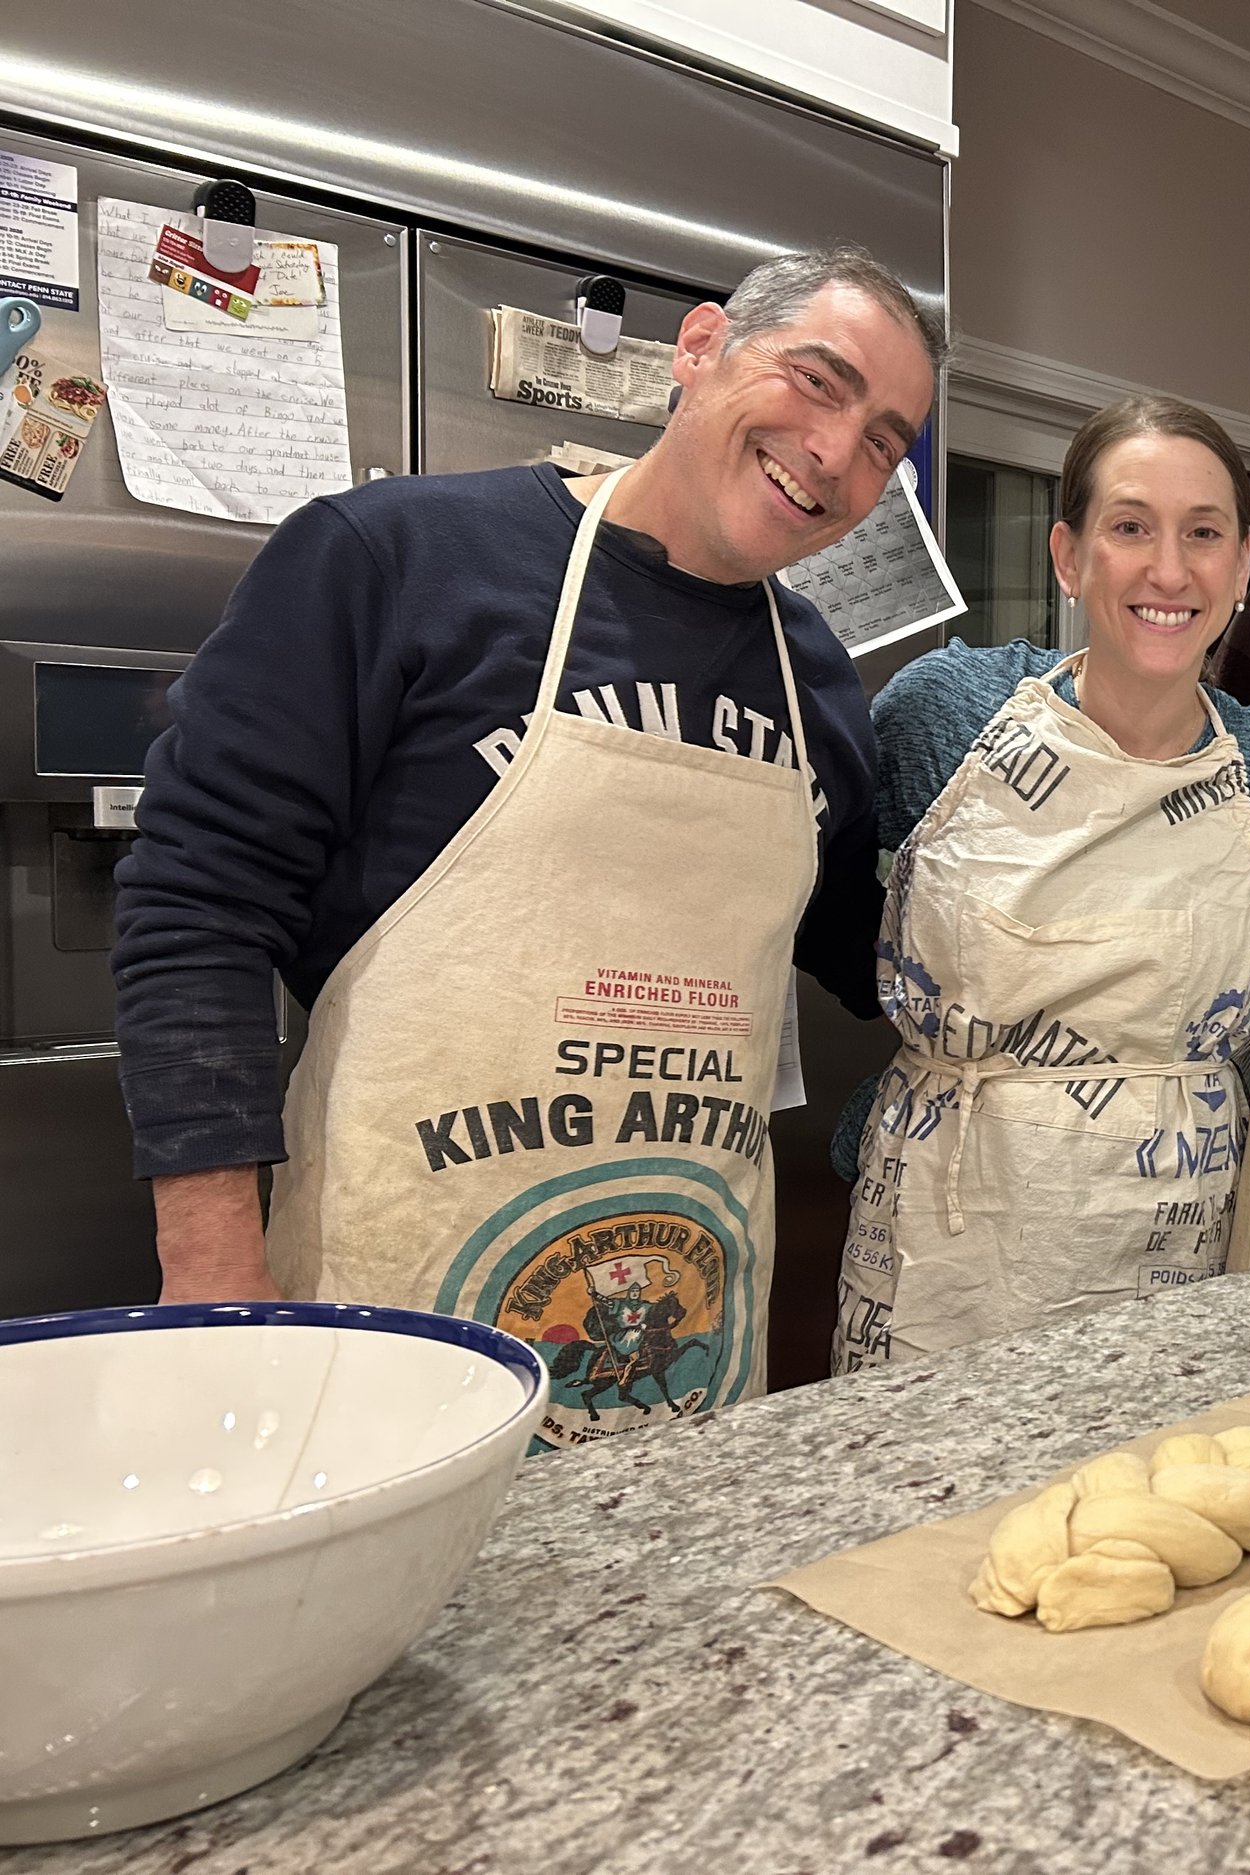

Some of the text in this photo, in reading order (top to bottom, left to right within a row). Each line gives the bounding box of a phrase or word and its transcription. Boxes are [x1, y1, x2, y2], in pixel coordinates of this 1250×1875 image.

[42, 199, 72, 210] Weekend
[15, 241, 36, 250] Classes
[36, 245, 53, 253] Begin
[21, 236, 39, 244] Arrival
[39, 239, 53, 247] Days
[8, 259, 40, 270] Final Exams
[16, 254, 34, 264] Spring
[34, 258, 50, 266] Break
[27, 284, 50, 294] PENN
[50, 288, 74, 299] STATE
[526, 325, 544, 337] WEEK
[550, 324, 581, 344] TEDDY
[517, 380, 582, 410] Sports
[145, 391, 182, 411] played
[235, 404, 248, 416] of
[265, 406, 294, 424] Bingo
[238, 422, 270, 437] After
[280, 427, 297, 440] the
[1, 438, 21, 468] FREE
[38, 453, 58, 484] FREE
[266, 463, 285, 476] and
[298, 464, 325, 480] then
[597, 968, 733, 991] VITAMIN AND MINERAL
[585, 980, 740, 1010] ENRICHED FLOUR
[555, 1039, 743, 1083] SPECIAL
[414, 1093, 594, 1173] KING
[1146, 1231, 1172, 1252] DE
[504, 1250, 574, 1321] KING
[567, 1220, 691, 1273] ARTHUR
